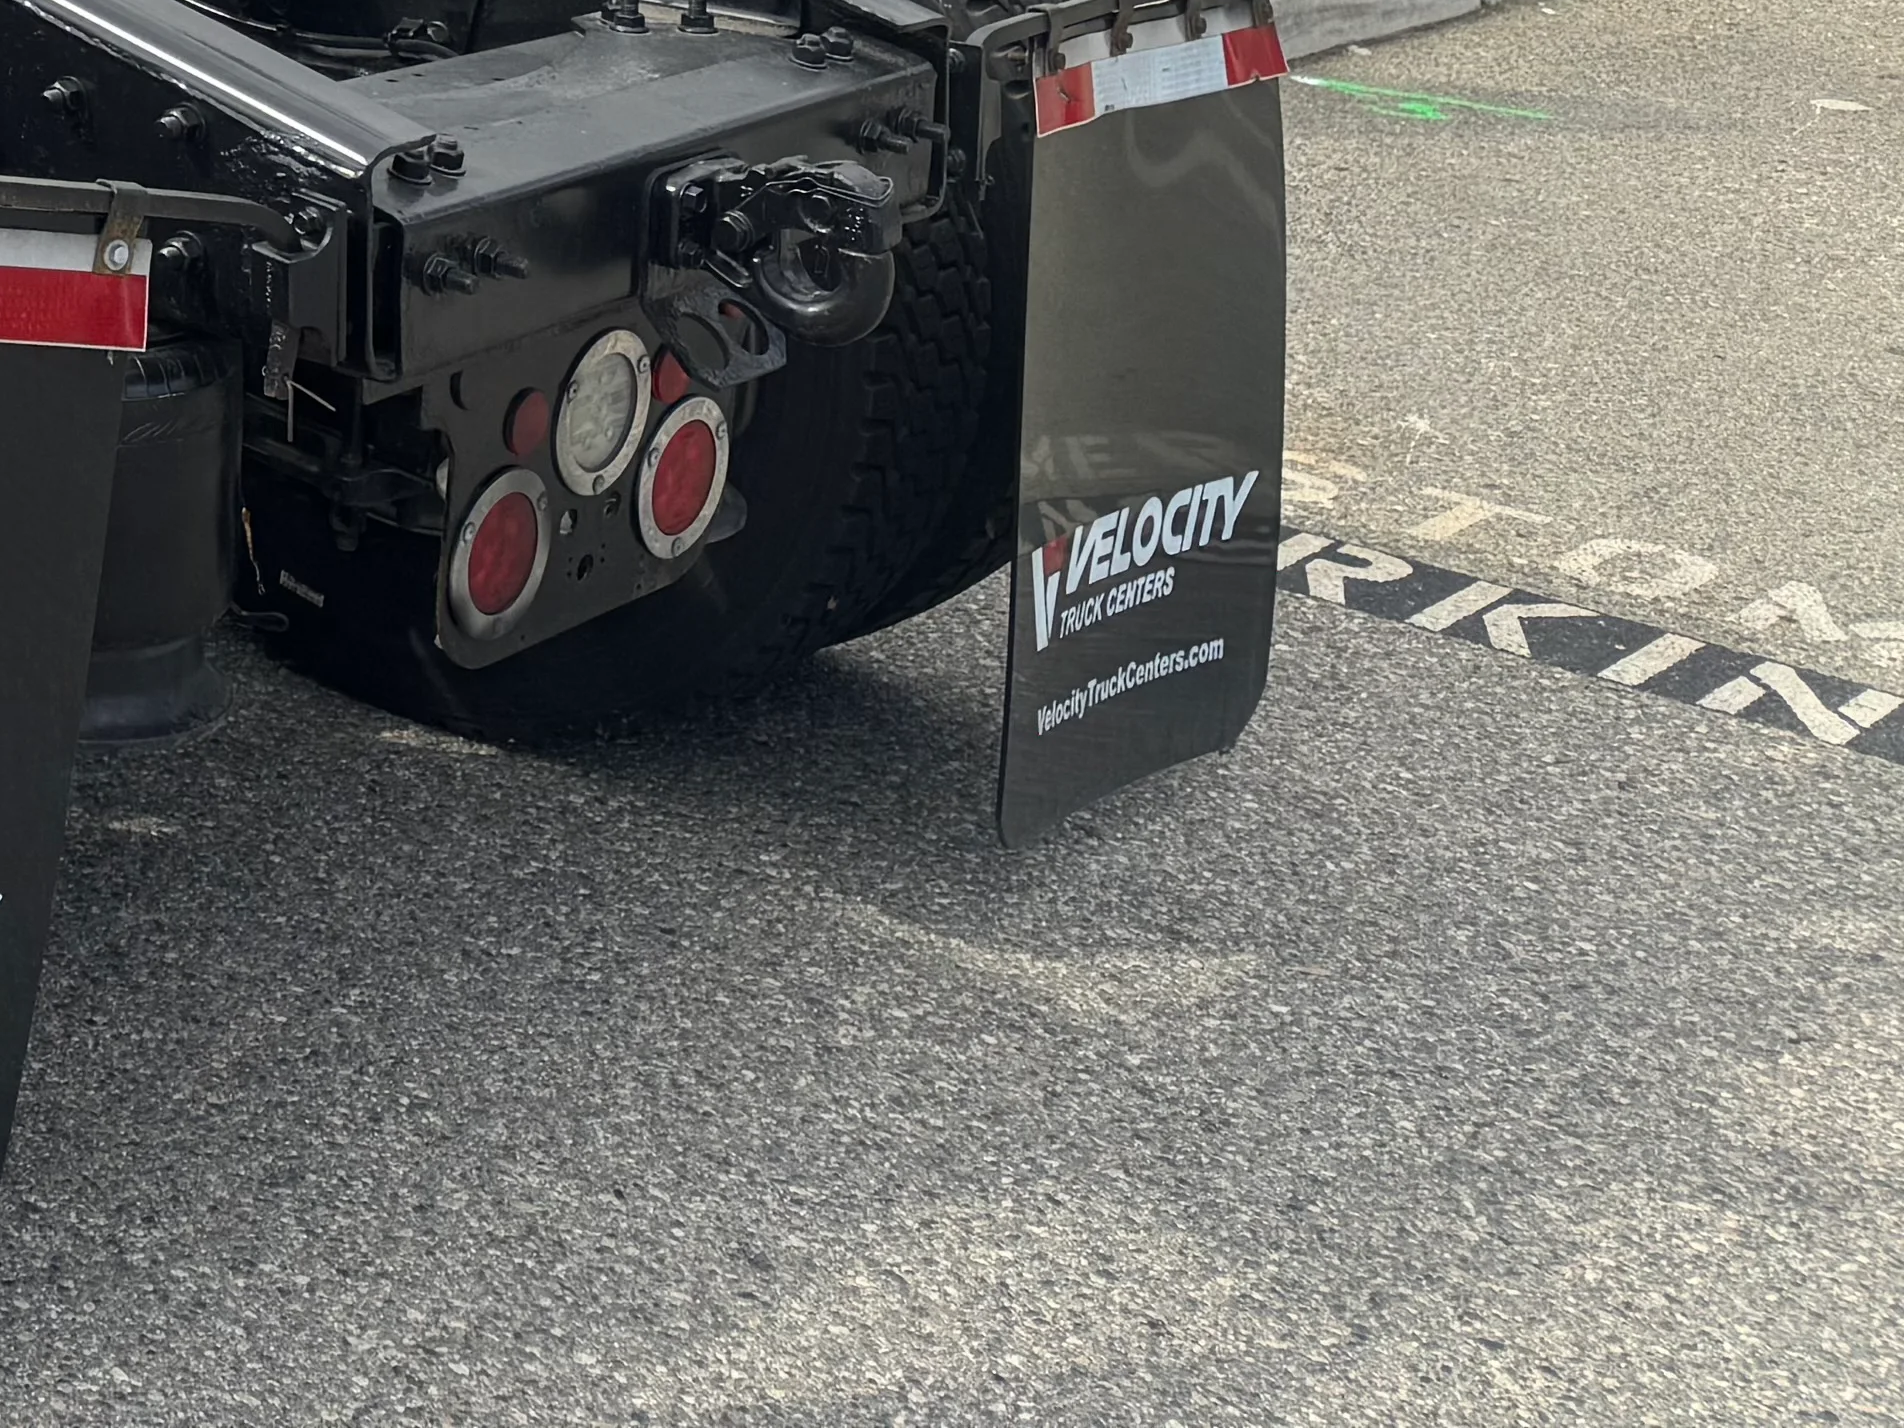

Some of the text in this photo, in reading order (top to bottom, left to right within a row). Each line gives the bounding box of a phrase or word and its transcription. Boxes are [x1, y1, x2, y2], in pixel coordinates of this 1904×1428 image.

[1065, 470, 1260, 595] VELOCITY
[1059, 566, 1176, 639] TRUCK CENTERS
[1037, 637, 1225, 737] VelocityTruckCenters.com
